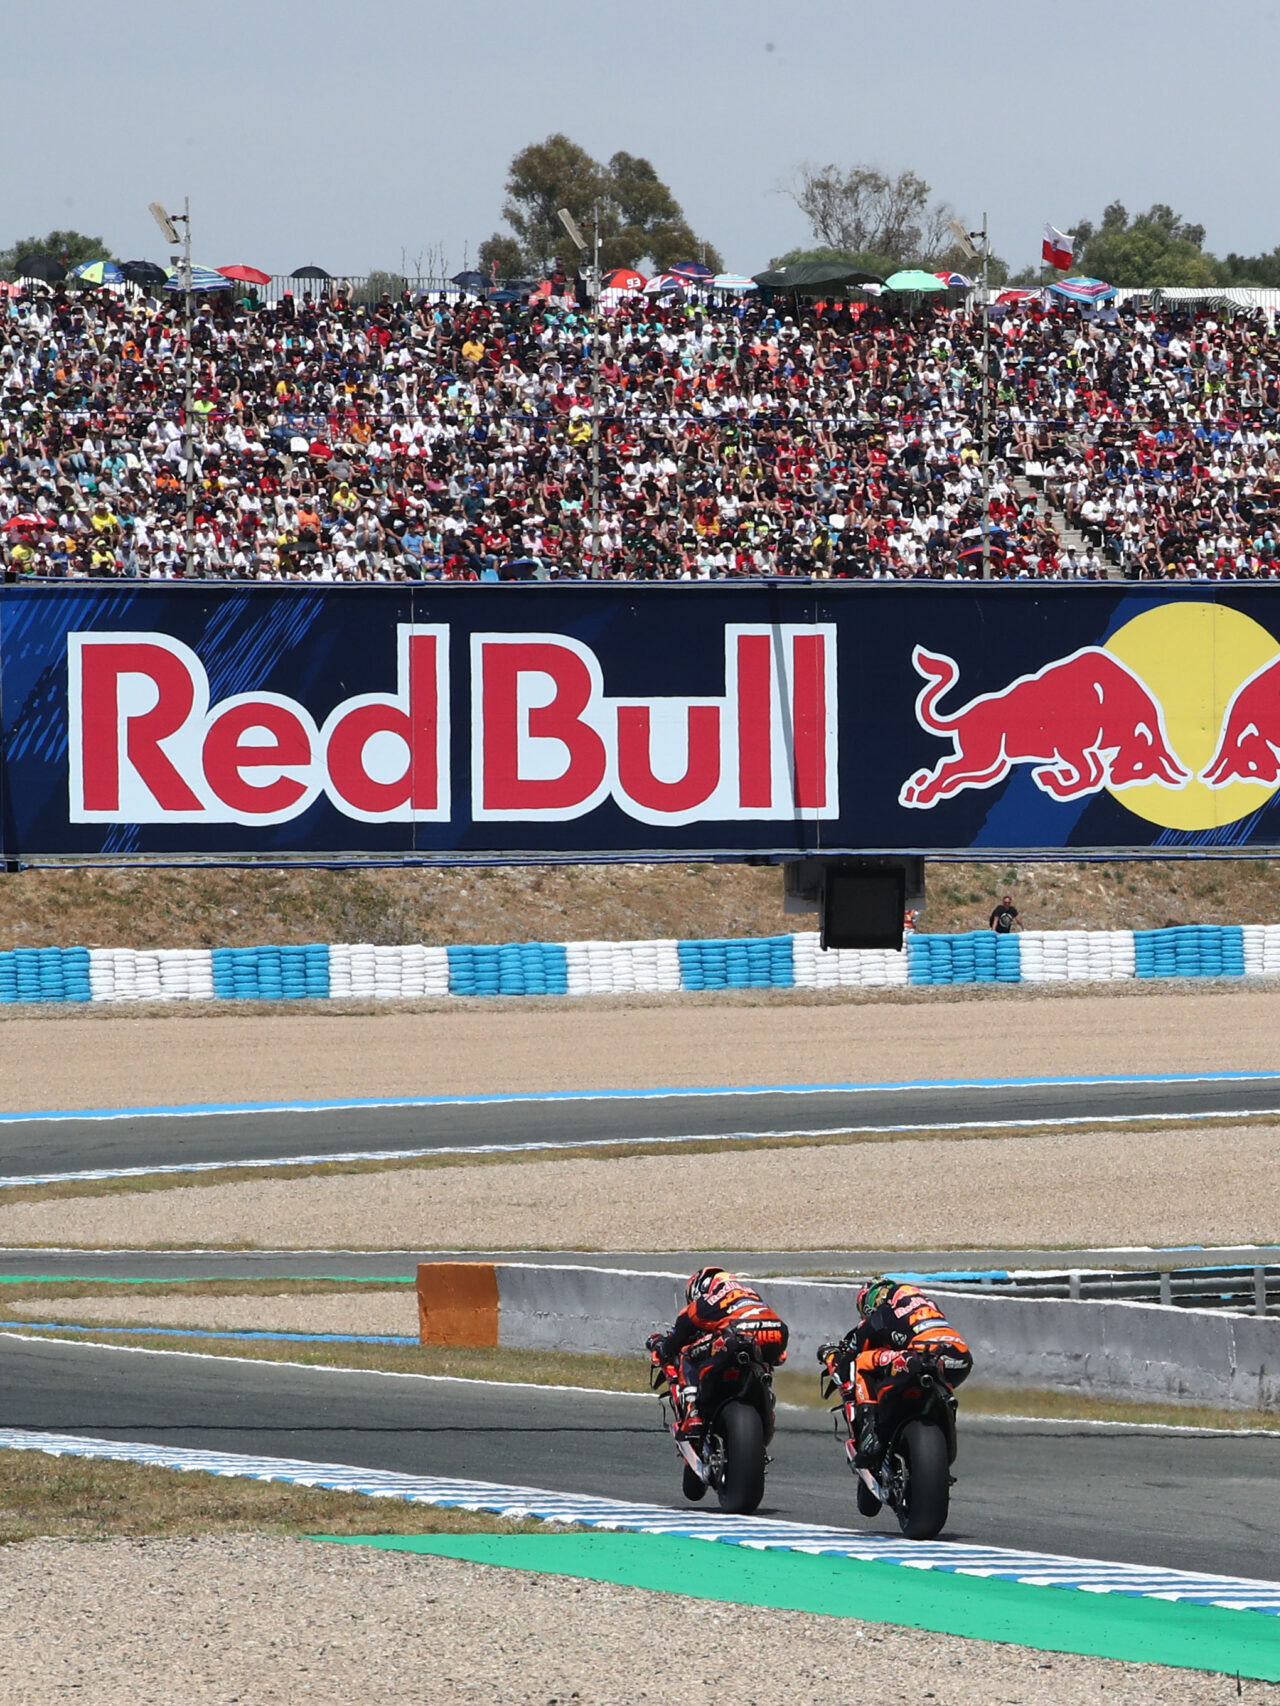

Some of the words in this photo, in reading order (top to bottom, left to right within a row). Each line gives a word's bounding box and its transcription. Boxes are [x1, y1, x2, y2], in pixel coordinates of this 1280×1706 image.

[626, 276, 642, 289] 93
[74, 630, 444, 820] Red
[477, 630, 833, 820] Bull
